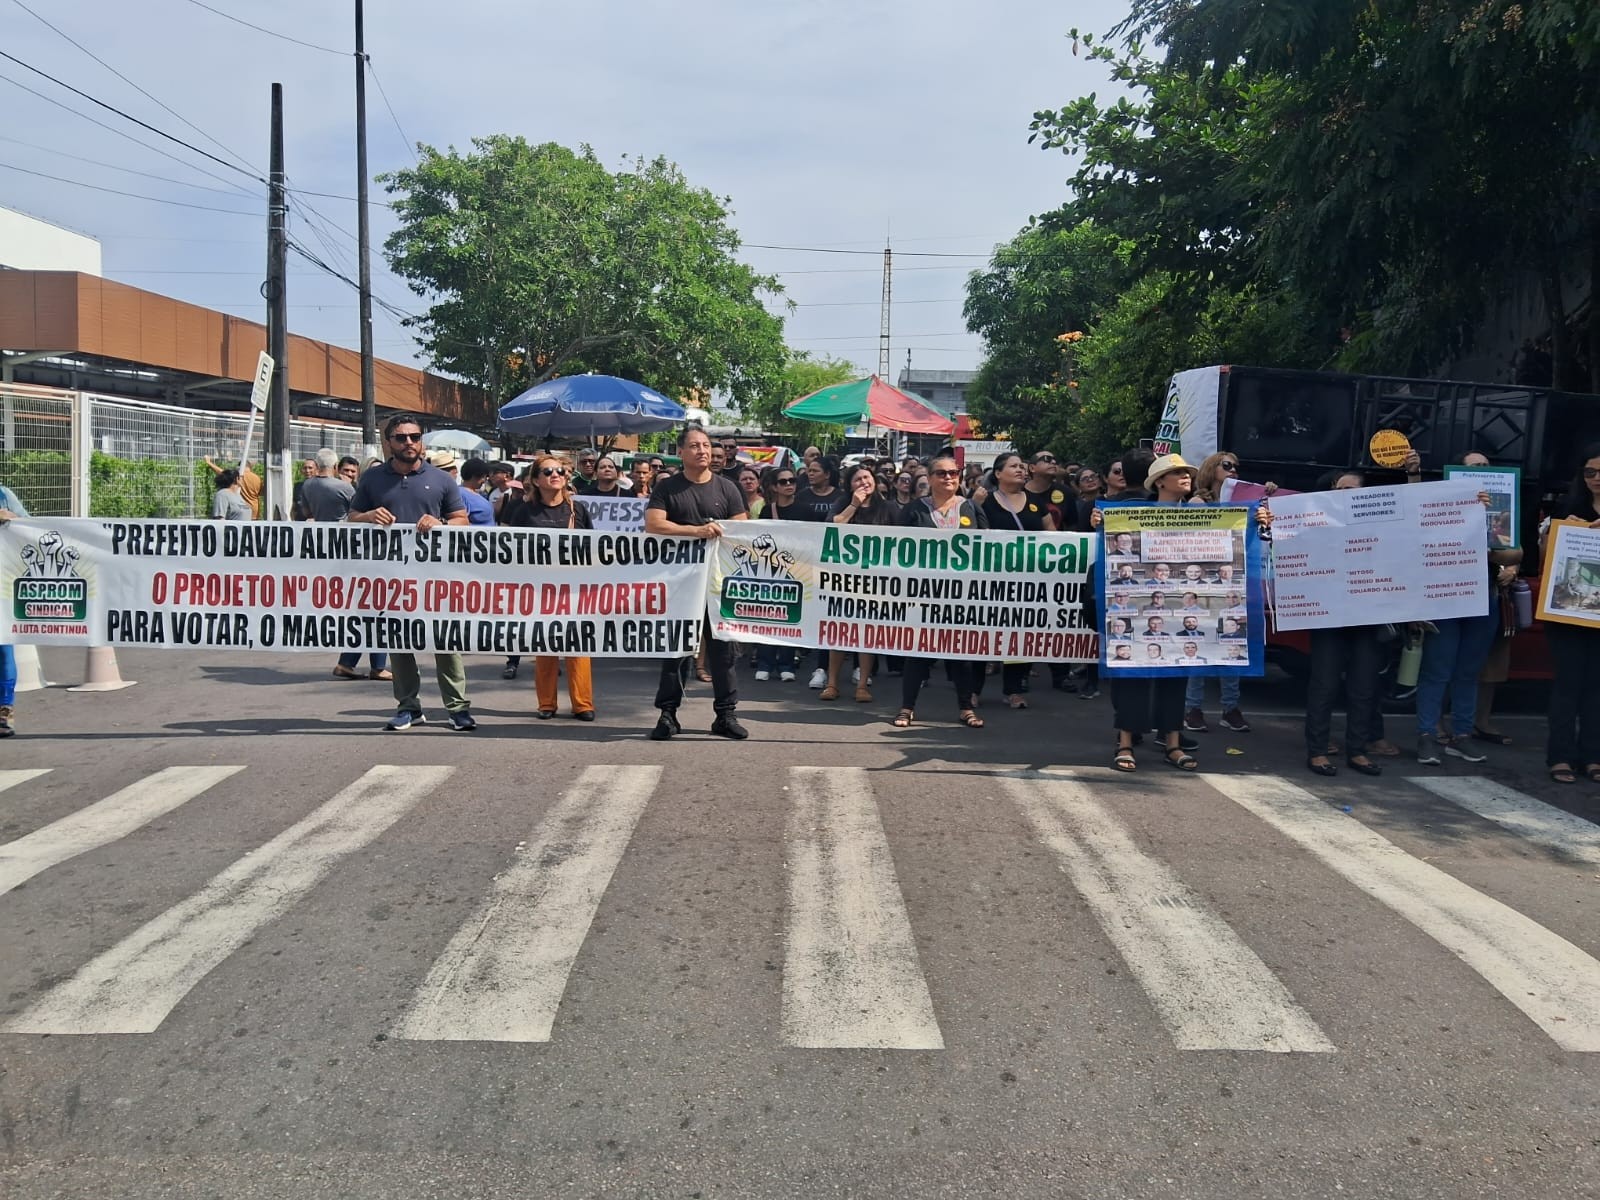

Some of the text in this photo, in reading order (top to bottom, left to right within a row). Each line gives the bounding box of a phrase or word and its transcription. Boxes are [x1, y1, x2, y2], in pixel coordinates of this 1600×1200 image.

[260, 363, 268, 382] E
[1351, 502, 1381, 510] INIMIGOS
[223, 525, 295, 558] DAVID
[415, 530, 442, 563] SE
[448, 530, 551, 565] INSISTIR
[559, 535, 592, 566] EM
[599, 535, 707, 565] COLOCAR
[820, 526, 1089, 575] AspromSindical
[18, 581, 82, 600] ASPROM
[152, 572, 167, 605] O
[173, 573, 275, 608] PROJETO
[312, 575, 418, 612] 08/2025
[424, 580, 538, 616] (PROJETO
[540, 583, 571, 616] DA
[577, 582, 667, 616] MORTE)
[726, 581, 797, 601] ASPROM
[819, 571, 901, 597] PREFEITO
[906, 576, 963, 600] DAVID
[967, 578, 1048, 603] ALMEIDA
[25, 602, 74, 617] SINDICAL
[734, 603, 788, 621] SINDICAL
[920, 602, 1052, 630] TRABALHANDO,
[11, 623, 88, 635] A LUTA CONTINUA
[107, 609, 701, 653] PARA VOTAR, O MAGISTÉRIO VAI DEFLAGAR A GREVE!
[752, 625, 802, 638] CONTINUA
[818, 619, 1100, 659] FORA DAVID ALMEIDA E A REFORMA
